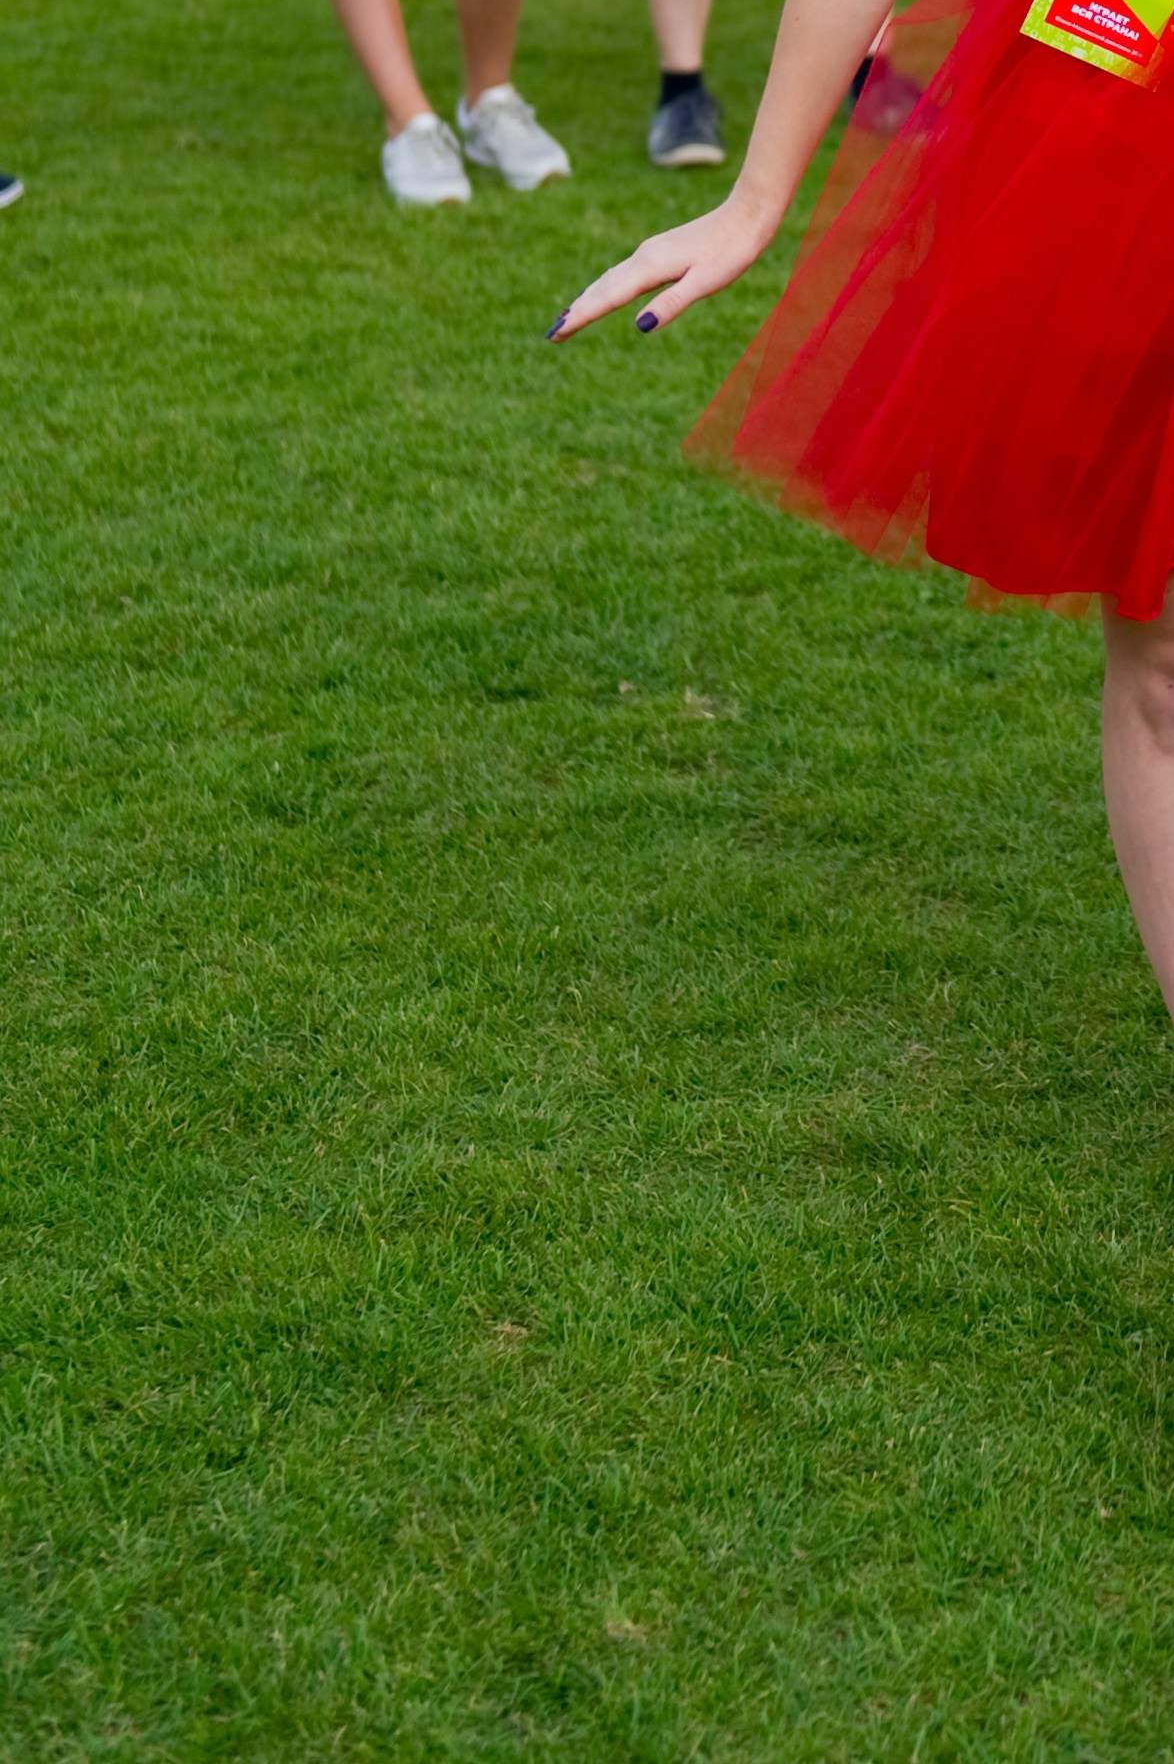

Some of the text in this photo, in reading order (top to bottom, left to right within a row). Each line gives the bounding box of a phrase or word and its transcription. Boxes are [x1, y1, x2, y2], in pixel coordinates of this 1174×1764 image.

[1071, 4, 1094, 20] ВСЯ
[1093, 15, 1140, 41] СТРАНА!
[1089, 2, 1130, 24] ИГРАЕТ
